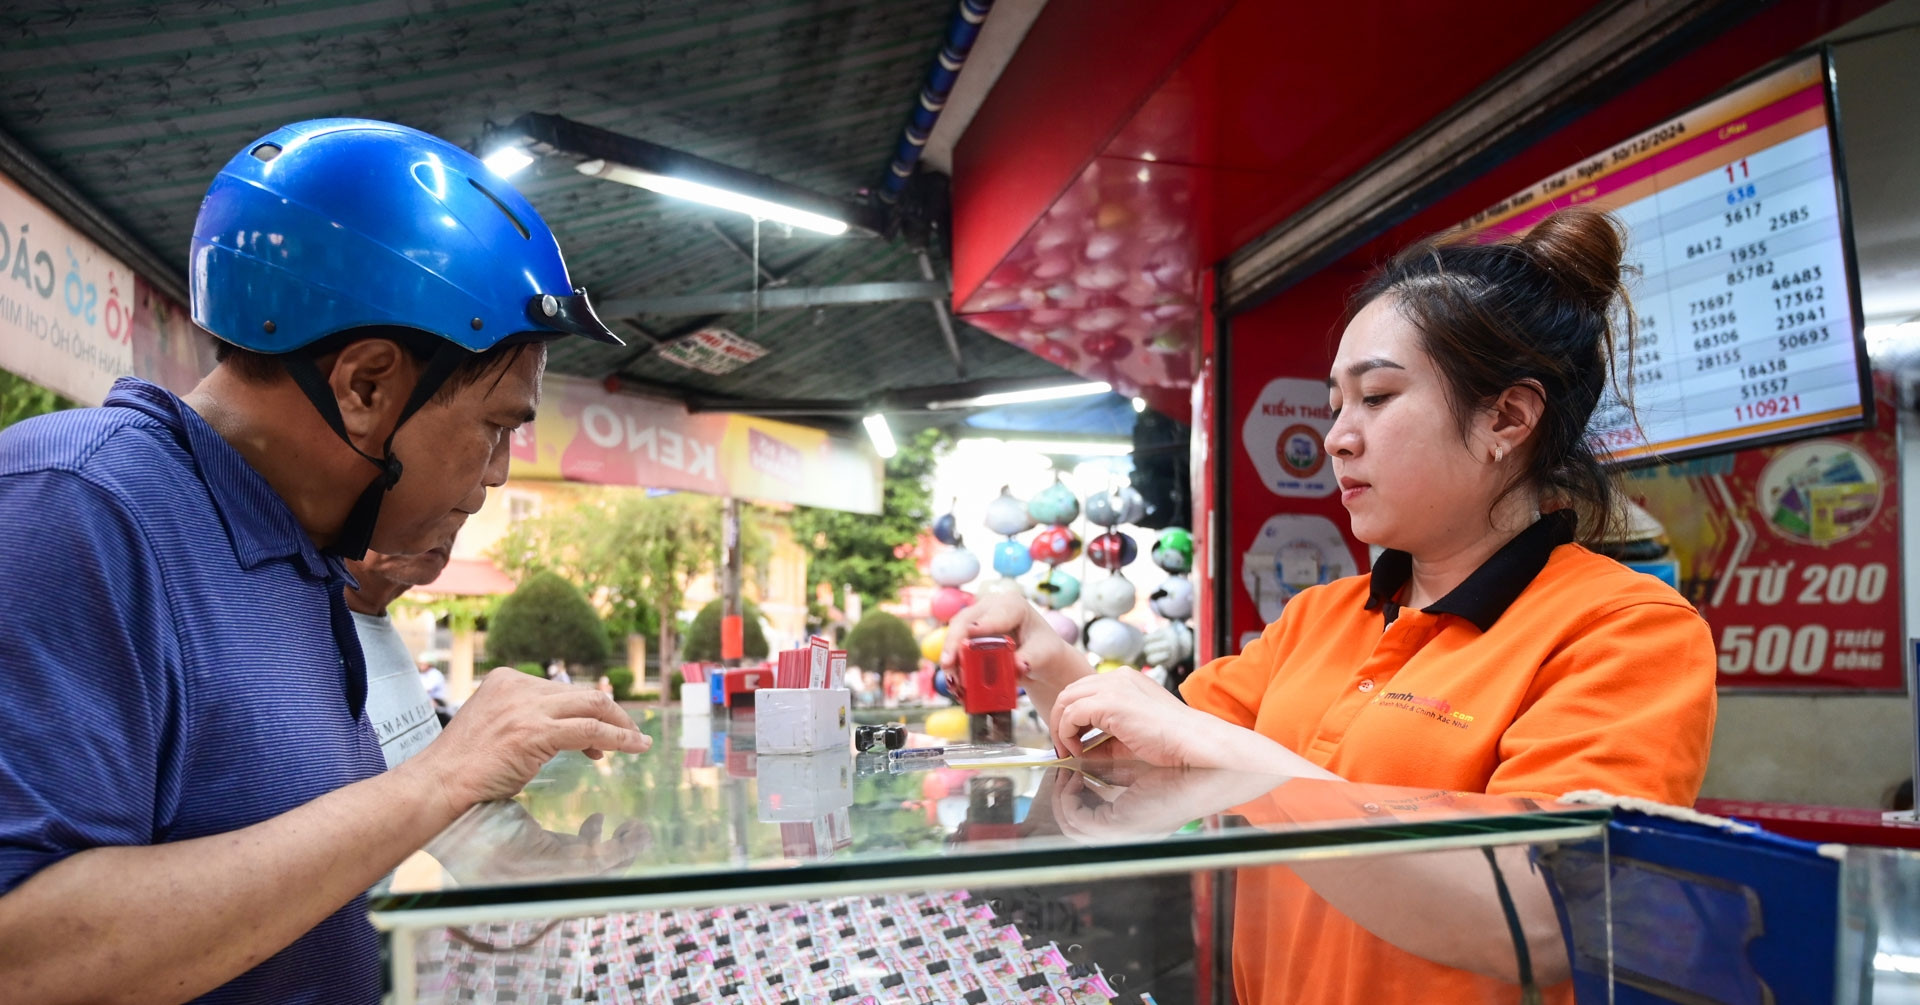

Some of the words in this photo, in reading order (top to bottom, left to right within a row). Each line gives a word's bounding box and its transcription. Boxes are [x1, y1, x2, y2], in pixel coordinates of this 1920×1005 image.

[1611, 122, 1686, 163] 30/12/2024
[1725, 158, 1749, 184] 11
[1726, 183, 1757, 205] 638
[1724, 202, 1763, 228] 3617
[1686, 235, 1723, 259] 8412
[1768, 204, 1810, 232] 2585
[1730, 240, 1768, 265] 1955
[1726, 260, 1775, 286] 85782
[1771, 264, 1823, 291] 46483
[1689, 291, 1734, 316] 73697
[1774, 285, 1825, 311] 17362
[1691, 310, 1737, 334] 35596
[1775, 305, 1826, 331] 23941
[1693, 329, 1739, 352] 68306
[1778, 326, 1830, 351] 50693
[1695, 349, 1742, 372] 28155
[1739, 358, 1788, 381] 18438
[1740, 377, 1789, 401] 51557
[1299, 402, 1333, 420] THIẾ
[1734, 394, 1801, 422] 110921
[1735, 559, 1796, 605] TỪ
[1797, 562, 1888, 605] 200
[1717, 624, 1829, 676] 500
